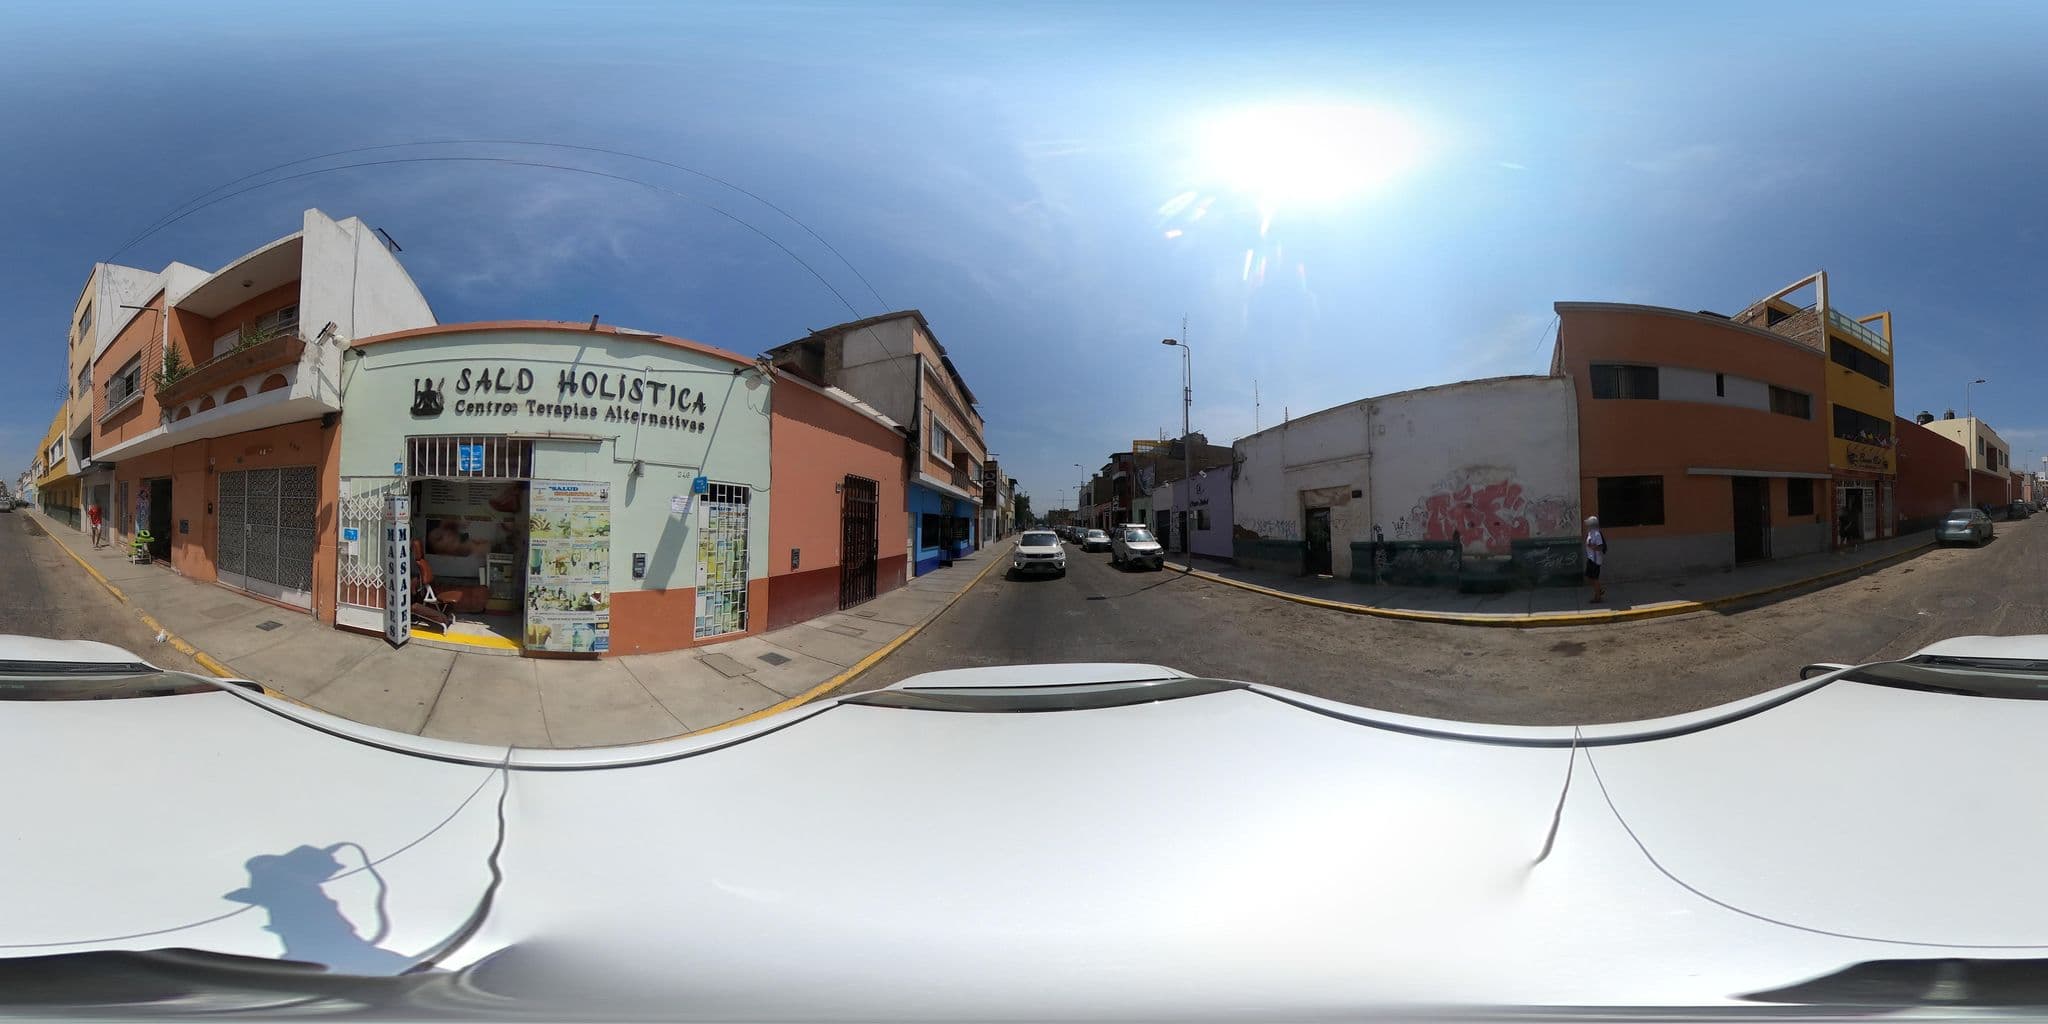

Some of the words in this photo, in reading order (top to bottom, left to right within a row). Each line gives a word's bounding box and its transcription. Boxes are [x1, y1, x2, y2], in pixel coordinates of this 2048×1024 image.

[526, 400, 598, 422] Terapias
[604, 405, 706, 434] Alternativas
[386, 528, 396, 637] MASAJES
[398, 528, 408, 637] MASAJES
